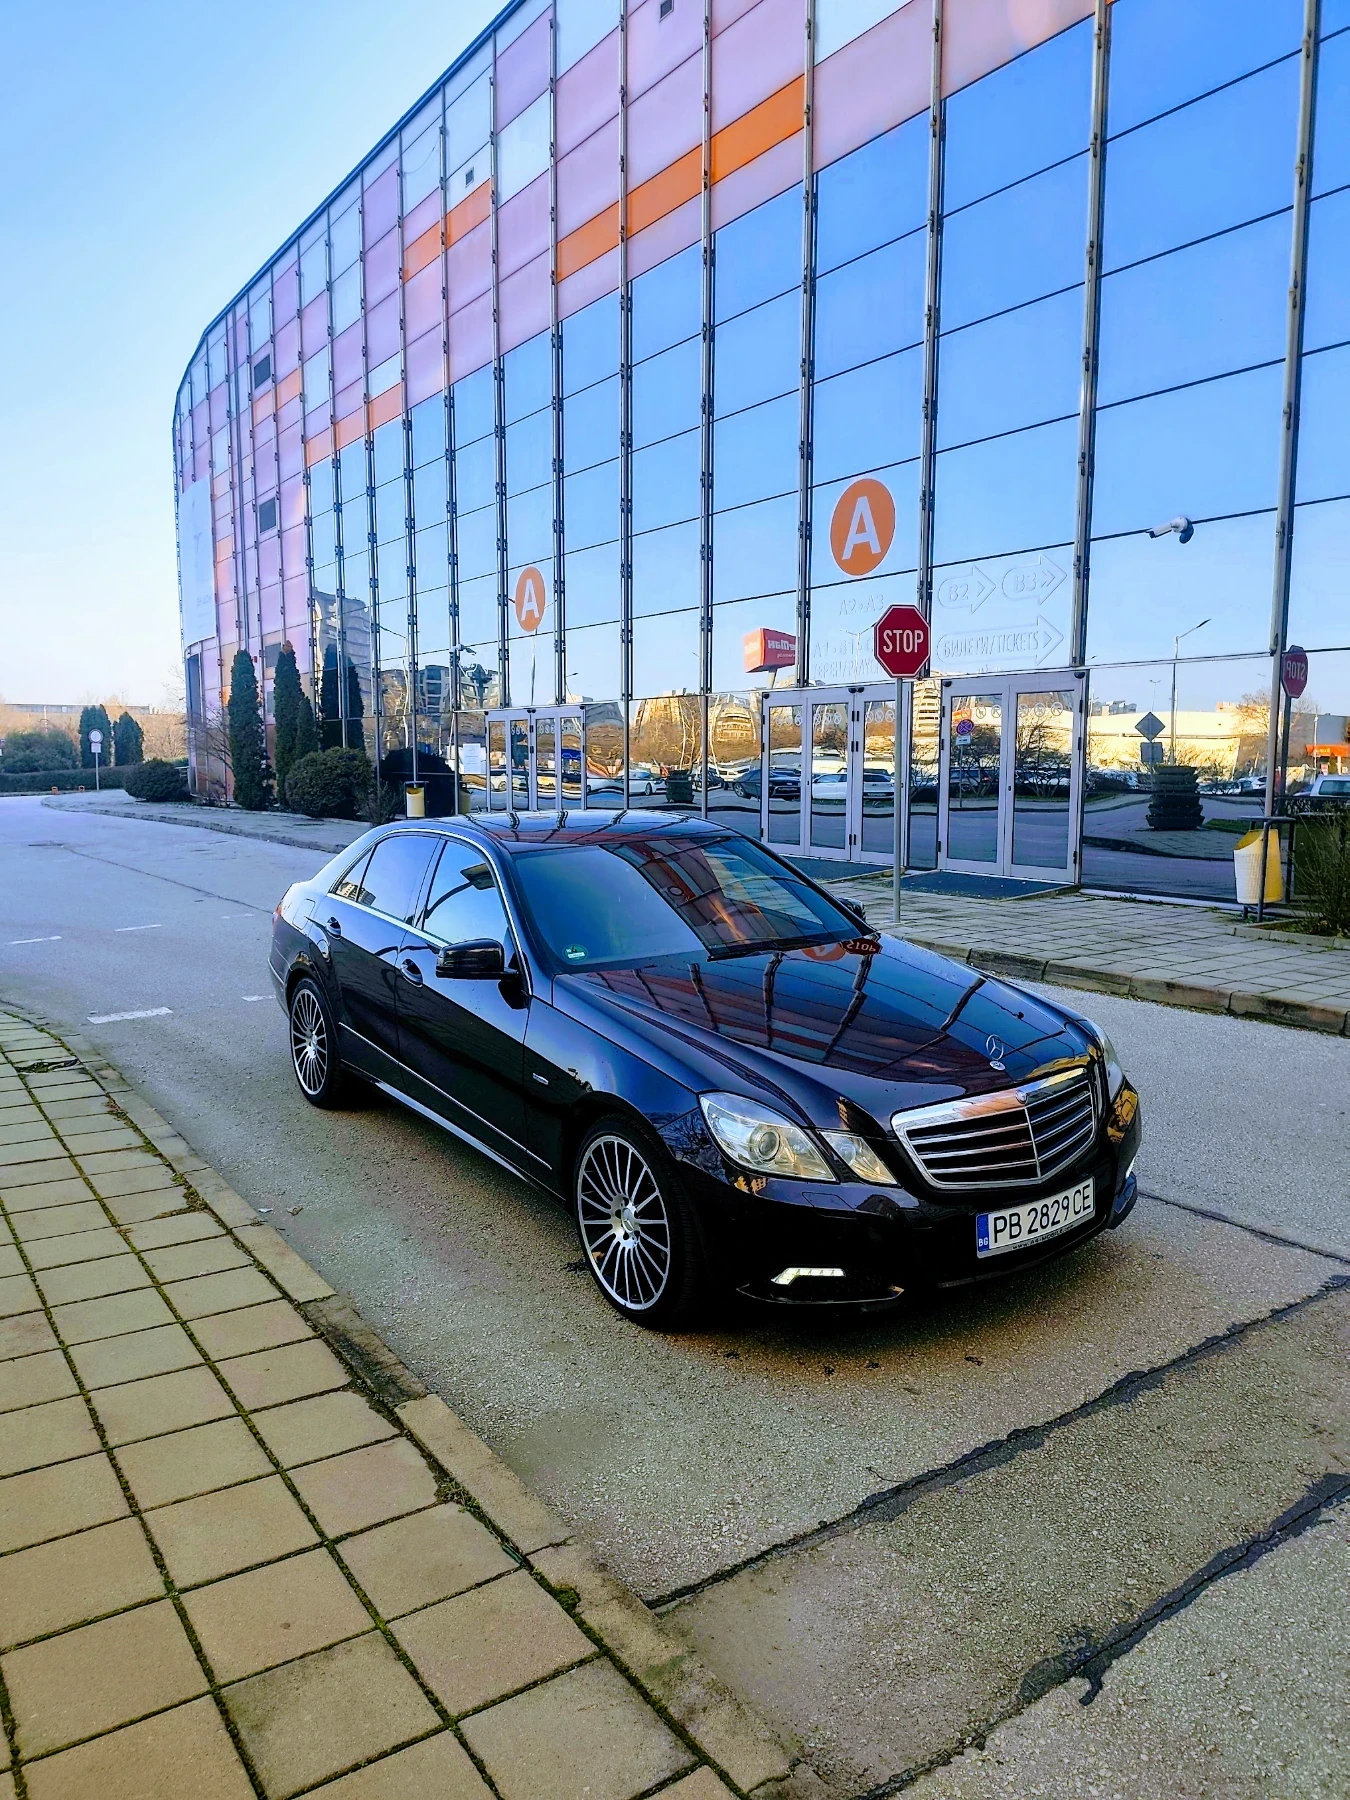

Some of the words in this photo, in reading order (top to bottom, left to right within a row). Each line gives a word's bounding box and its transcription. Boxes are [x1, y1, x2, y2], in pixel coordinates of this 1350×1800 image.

[842, 496, 882, 560] A
[1013, 572, 1037, 593] B3
[521, 578, 540, 621] A
[883, 629, 924, 653] STOP
[994, 1212, 1022, 1243] PB
[1027, 1195, 1070, 1234] 2829
[1073, 1184, 1091, 1215] CE
[978, 1237, 989, 1247] BG
